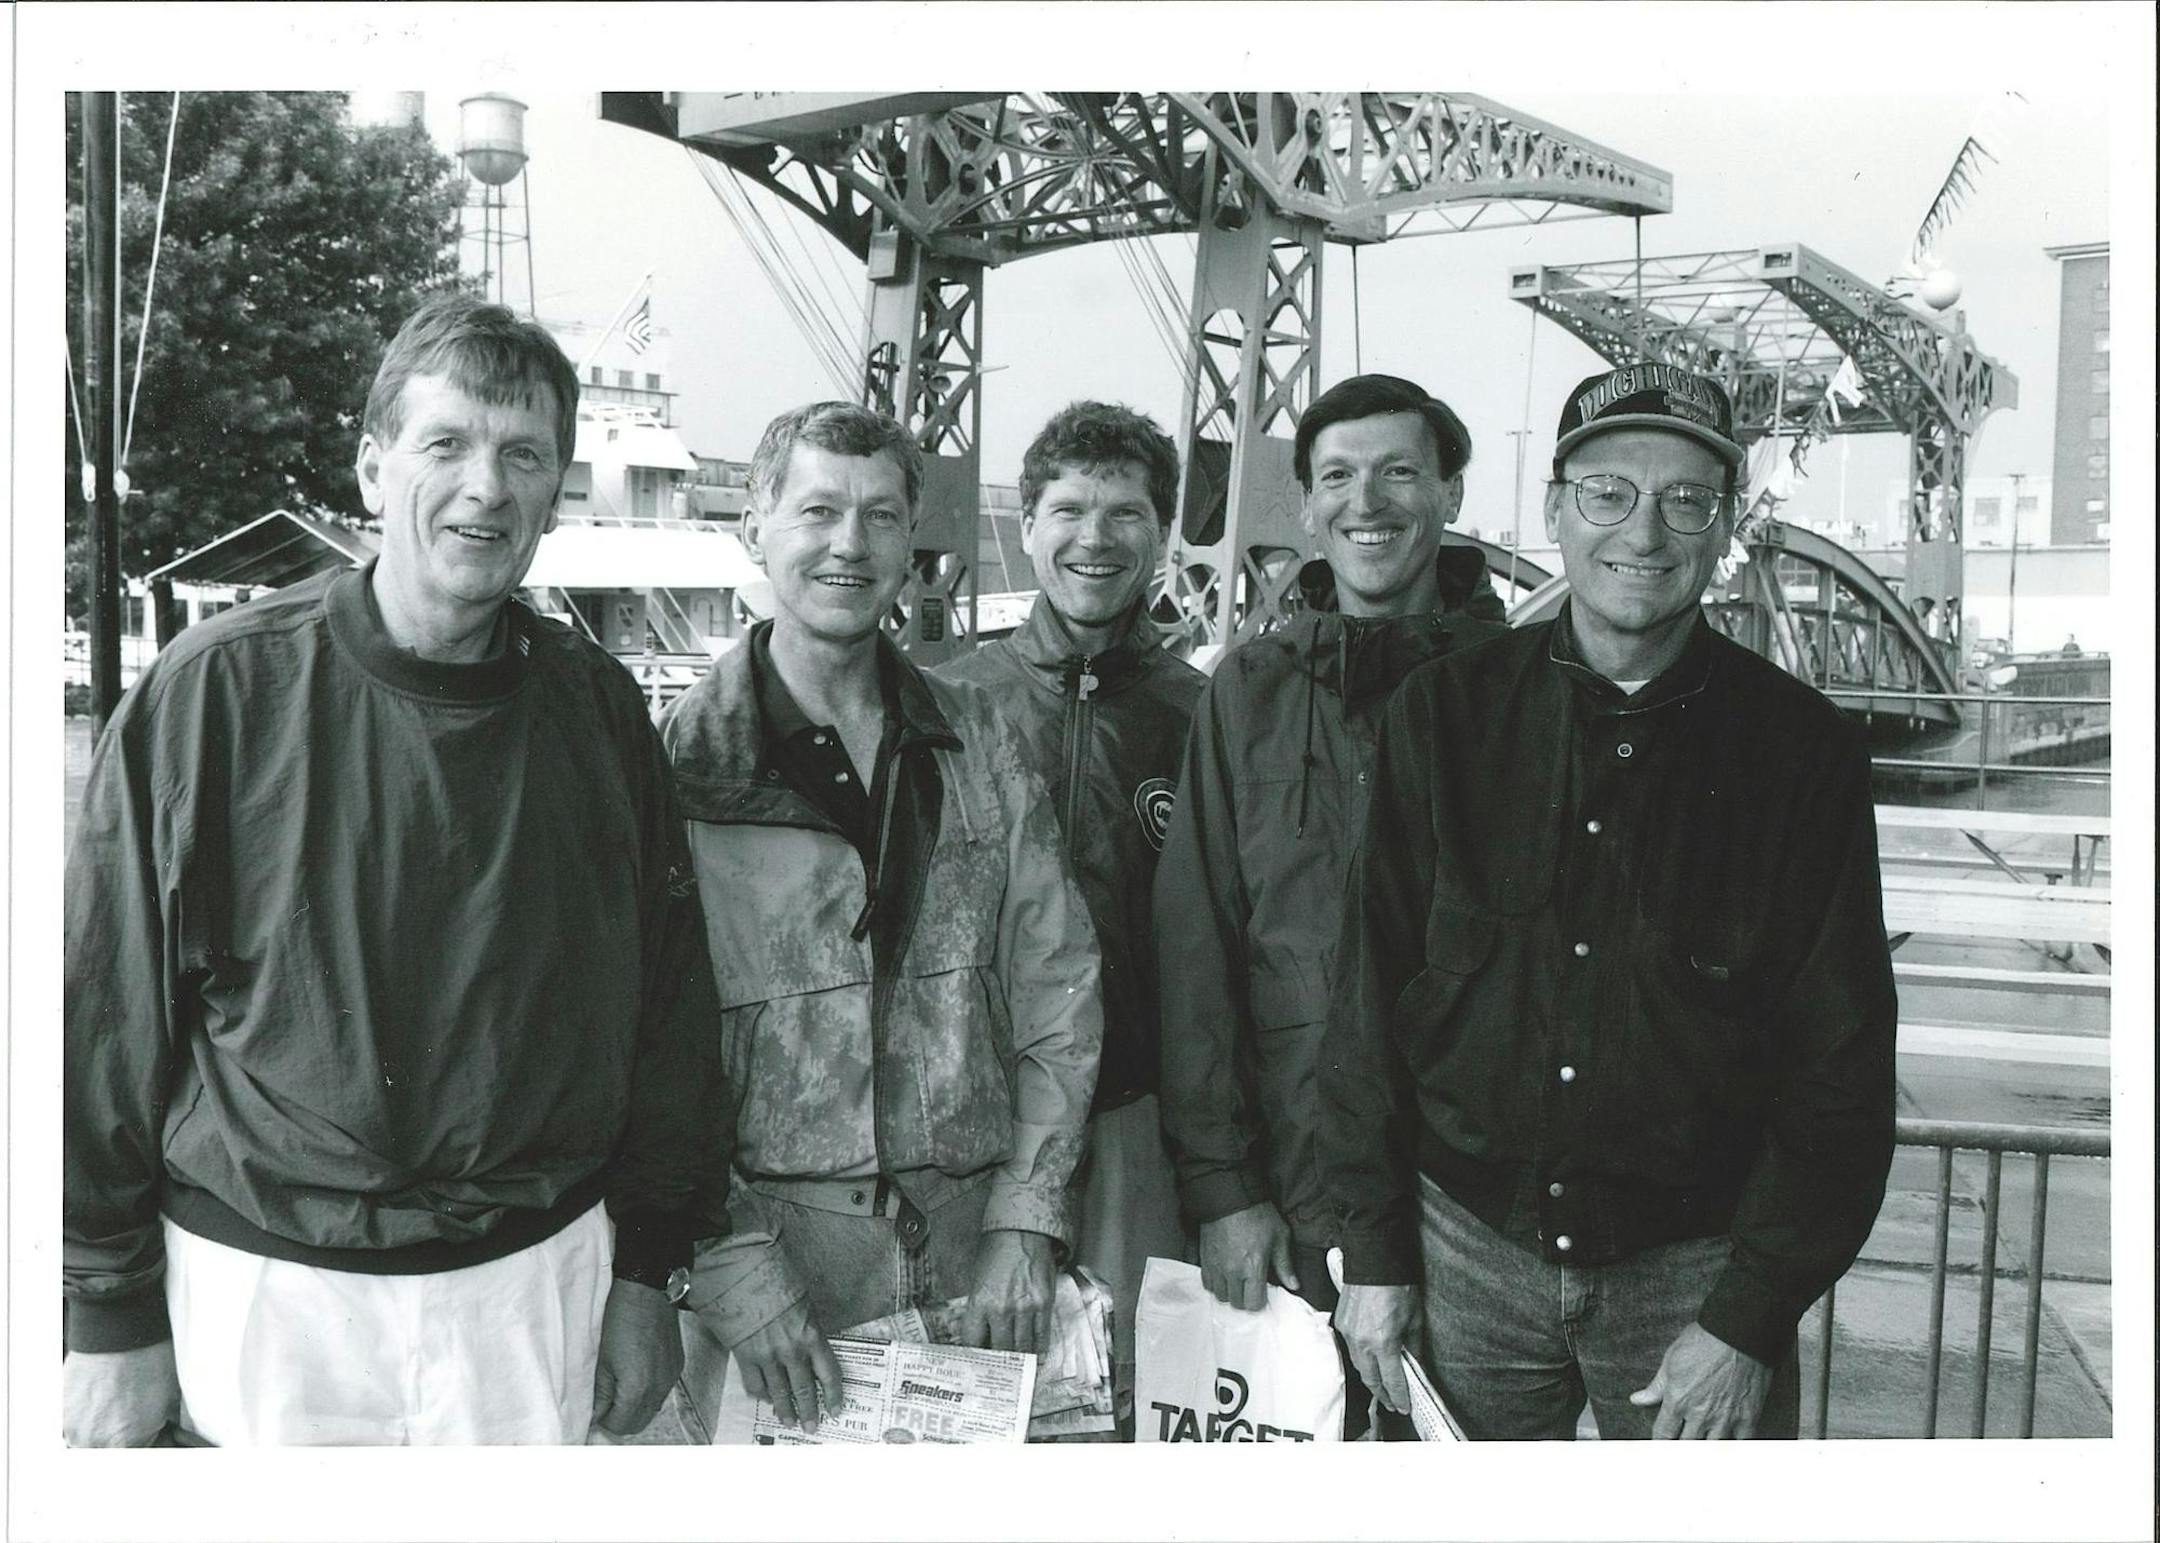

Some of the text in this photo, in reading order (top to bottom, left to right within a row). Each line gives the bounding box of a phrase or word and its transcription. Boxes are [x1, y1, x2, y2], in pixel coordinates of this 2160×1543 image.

[903, 1362, 933, 1374] HAPPY
[899, 1379, 965, 1403] Sneakers
[845, 1419, 868, 1431] PUB
[894, 1405, 954, 1435] FREE
